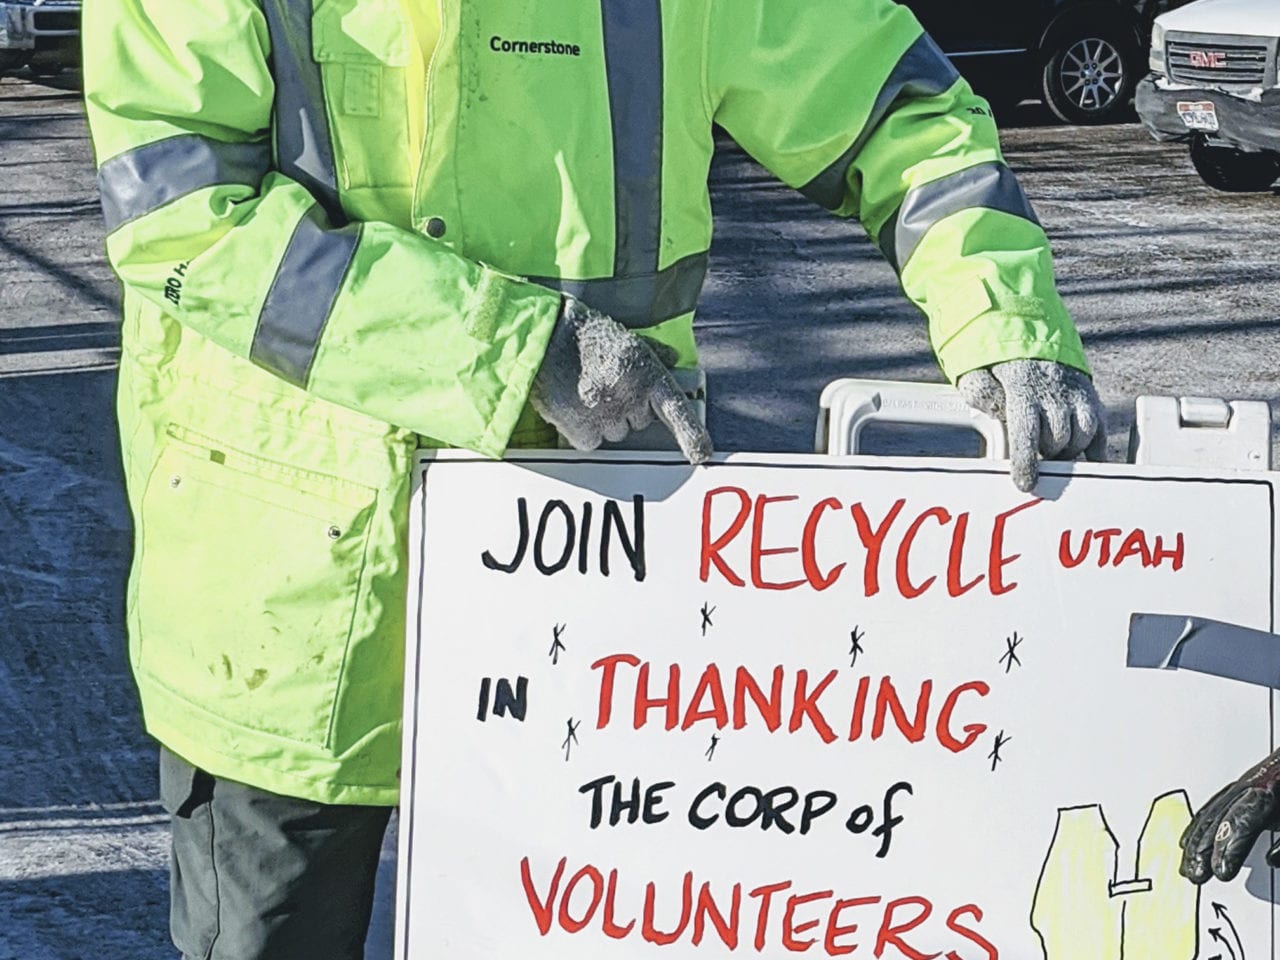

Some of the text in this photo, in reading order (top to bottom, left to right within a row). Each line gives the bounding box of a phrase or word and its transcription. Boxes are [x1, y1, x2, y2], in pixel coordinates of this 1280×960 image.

[489, 36, 580, 56] Cornerstone
[1189, 51, 1226, 68] GMC
[480, 485, 1185, 600] JOIN RECYCLE UTAH
[477, 653, 991, 754] IN THANKING
[578, 774, 914, 859] THE CORP of
